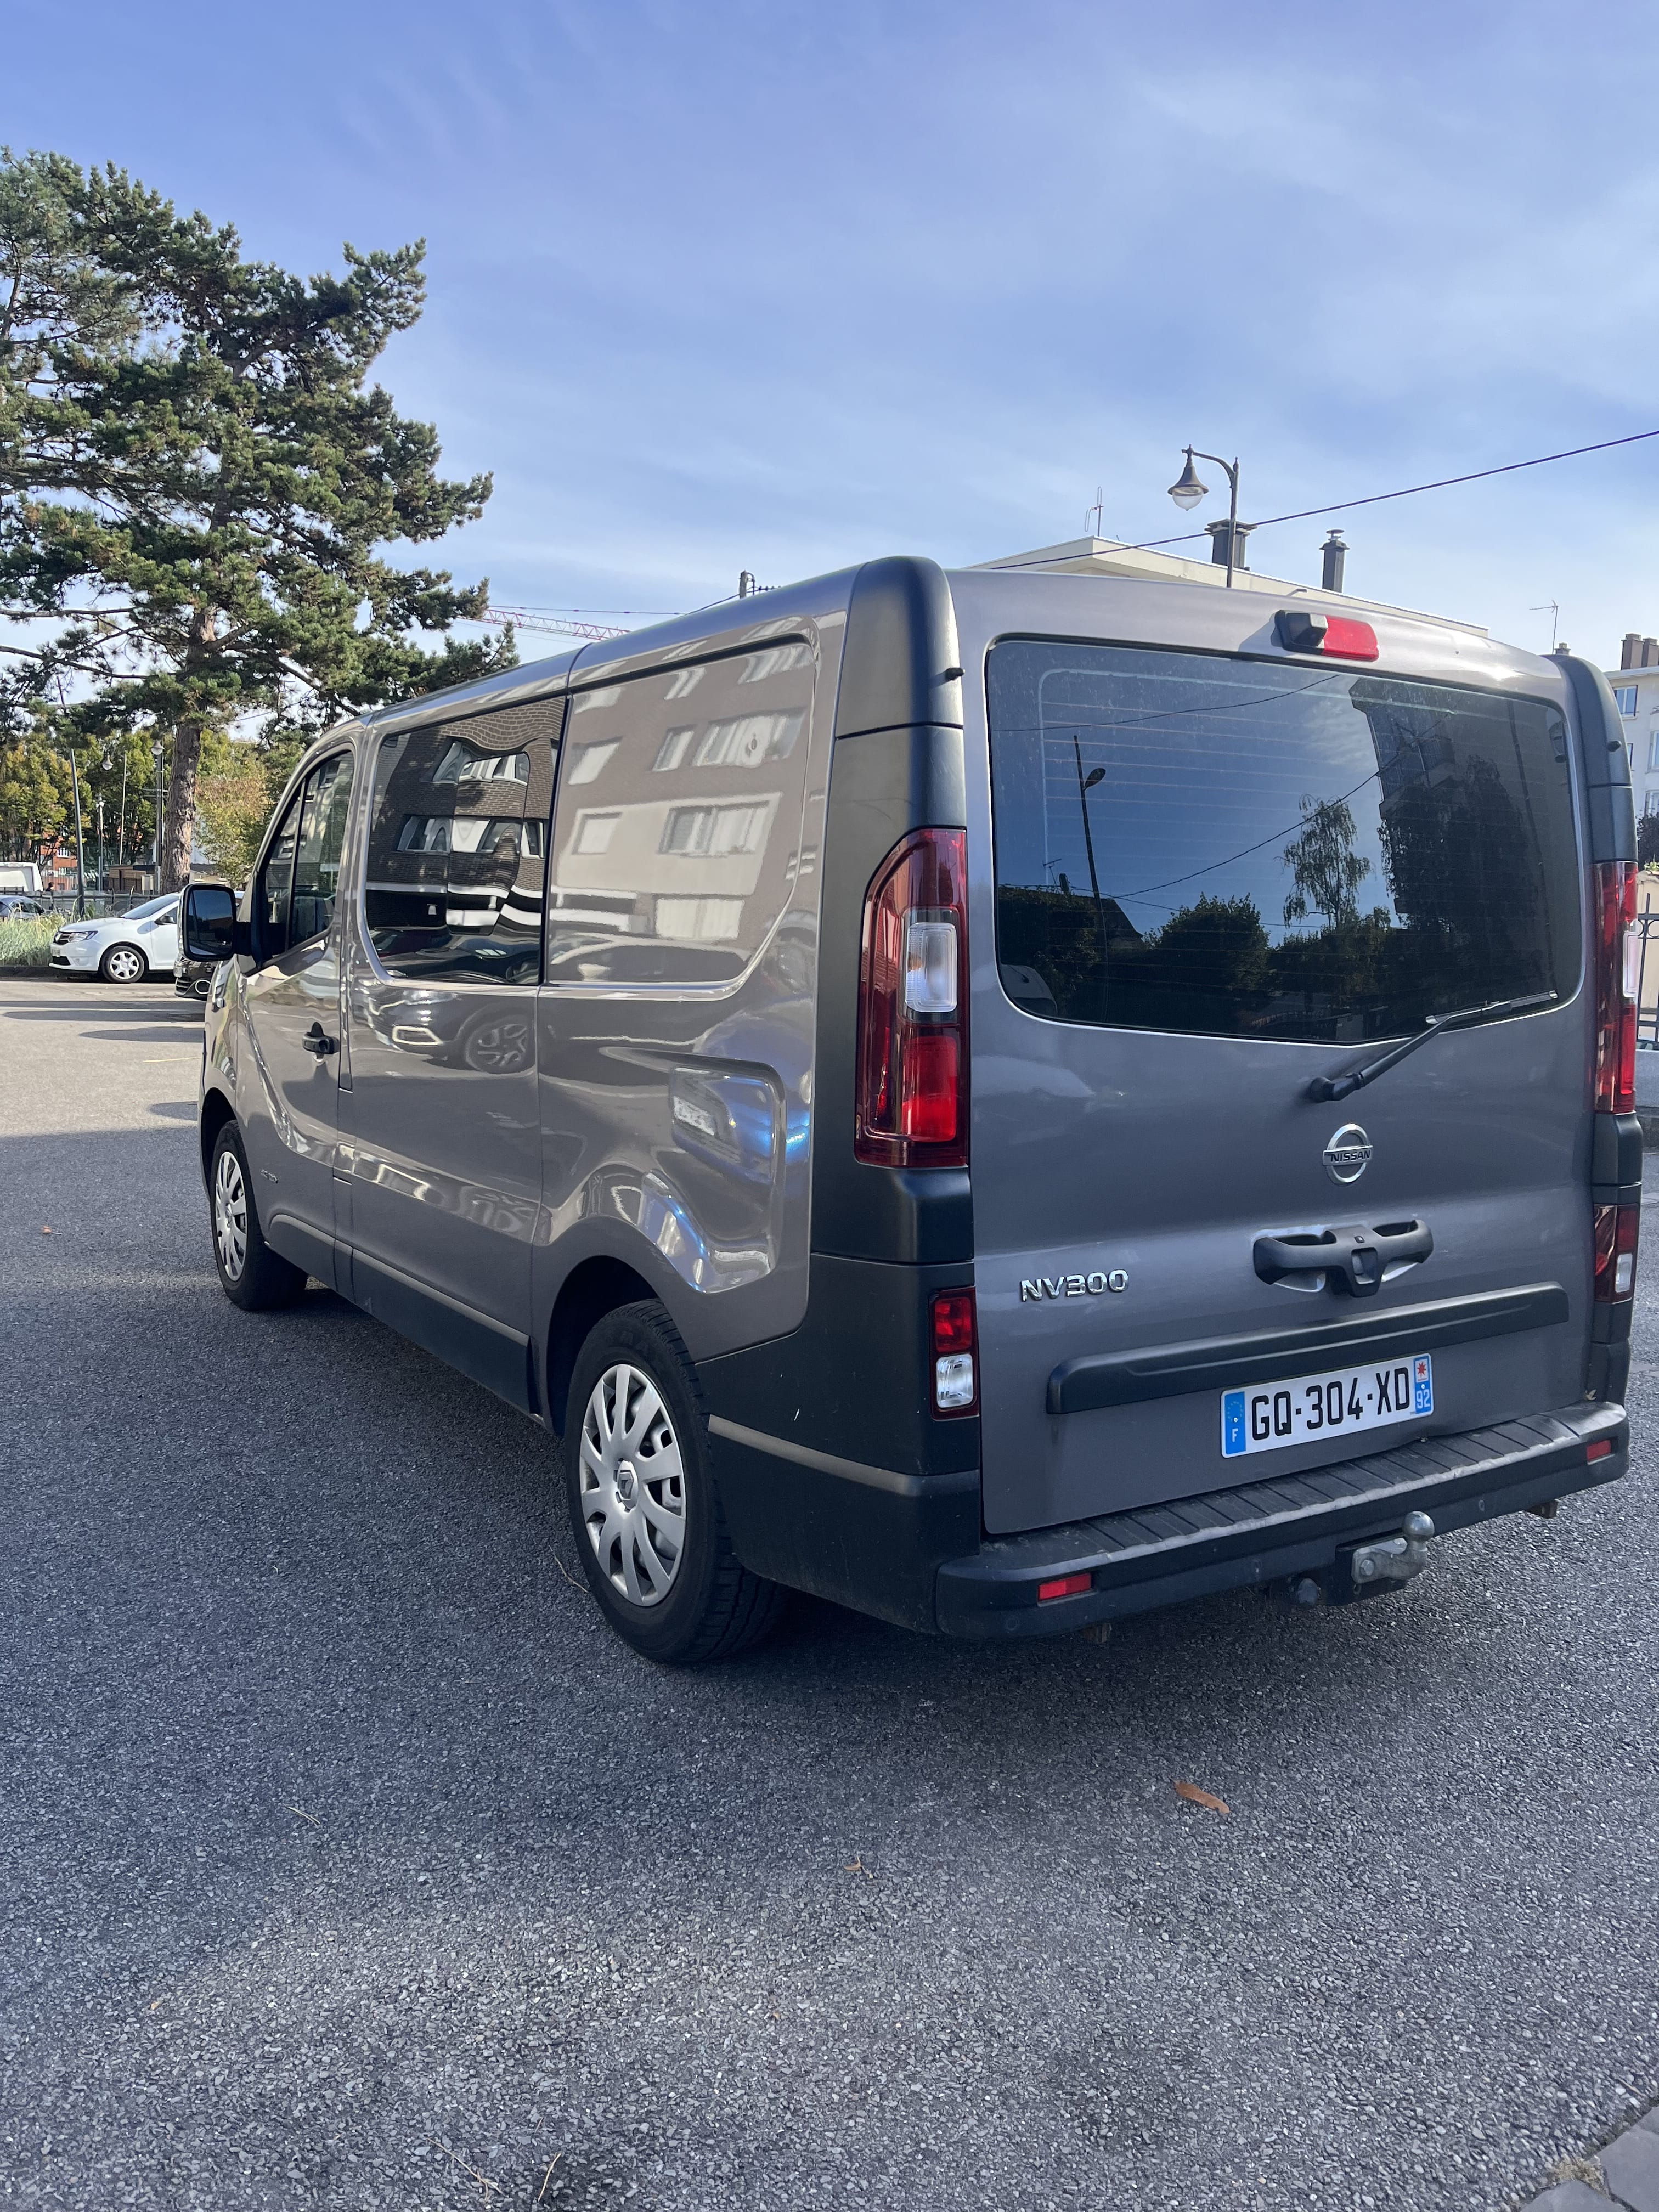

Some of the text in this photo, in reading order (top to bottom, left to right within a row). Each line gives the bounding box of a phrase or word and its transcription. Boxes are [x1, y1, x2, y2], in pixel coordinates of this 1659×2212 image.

[1330, 1150, 1370, 1162] NISSAN
[1020, 1269, 1128, 1302] NV300
[1231, 1428, 1239, 1442] F
[1416, 1389, 1431, 1409] 92
